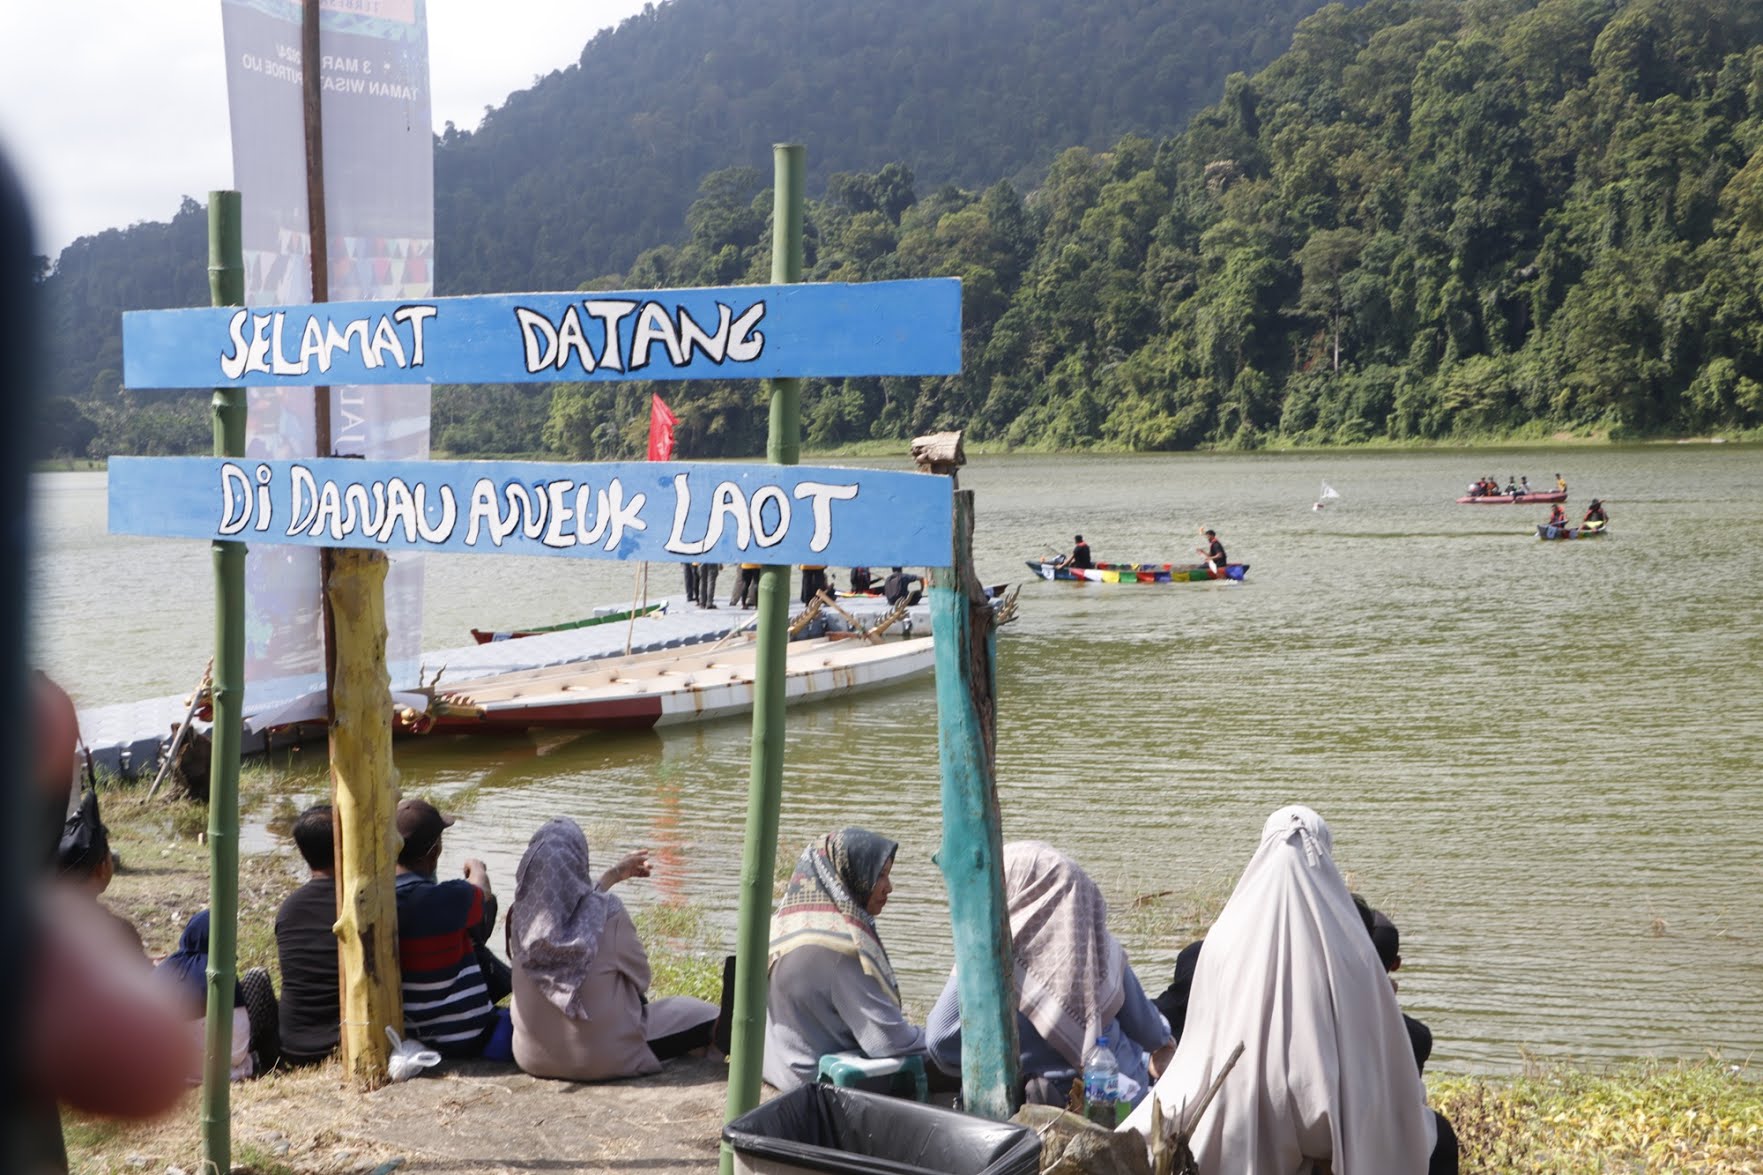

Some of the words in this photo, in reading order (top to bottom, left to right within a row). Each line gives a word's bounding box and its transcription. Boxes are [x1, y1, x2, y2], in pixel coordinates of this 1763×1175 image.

[220, 304, 438, 380] SELAMAT
[514, 300, 767, 374] DATANG
[218, 462, 272, 535] Di
[285, 464, 458, 544] DANAU
[464, 476, 647, 552] ANEUK
[663, 472, 860, 555] LAOT
